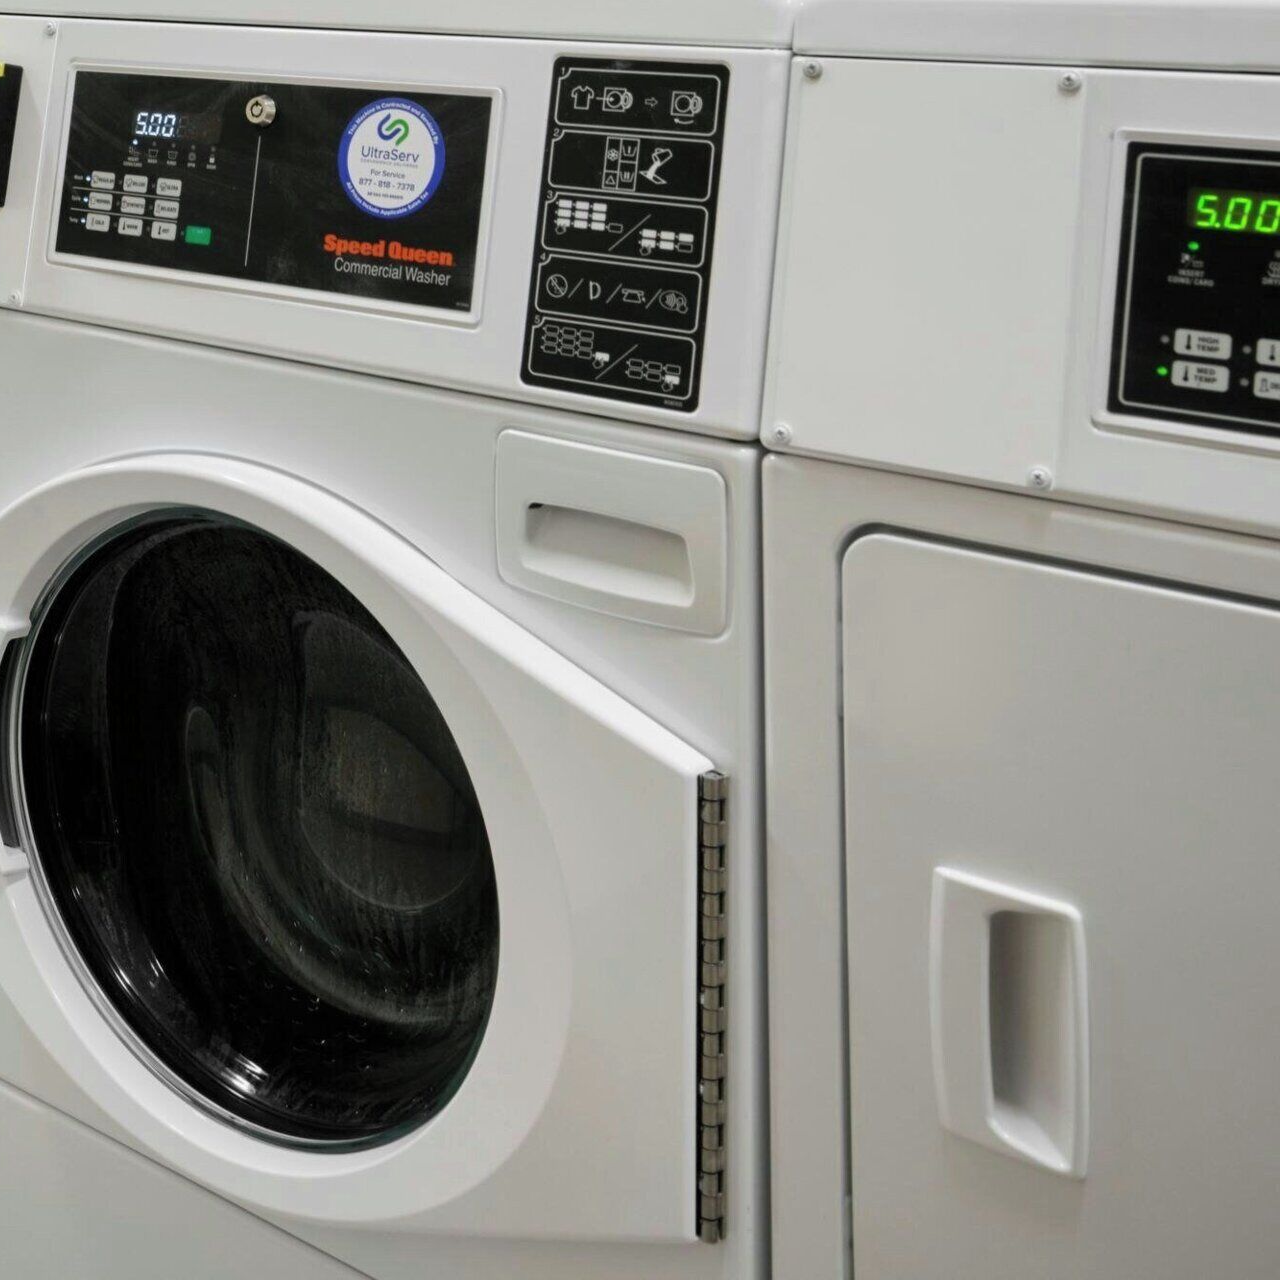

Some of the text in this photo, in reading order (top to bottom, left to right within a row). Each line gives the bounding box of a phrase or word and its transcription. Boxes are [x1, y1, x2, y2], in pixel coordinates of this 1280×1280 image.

[135, 112, 176, 138] 5.00
[361, 145, 420, 162] UltraServ
[370, 168, 406, 179] For Service
[1196, 194, 1280, 234] 5.00
[323, 233, 454, 266] Speed Queen
[334, 256, 451, 286] Commercial Washer
[1178, 268, 1205, 278] INSERT
[1198, 336, 1220, 344] HIGH
[1196, 344, 1220, 352] TEMP
[1196, 367, 1216, 376] MED
[1194, 375, 1218, 384] TEMP
